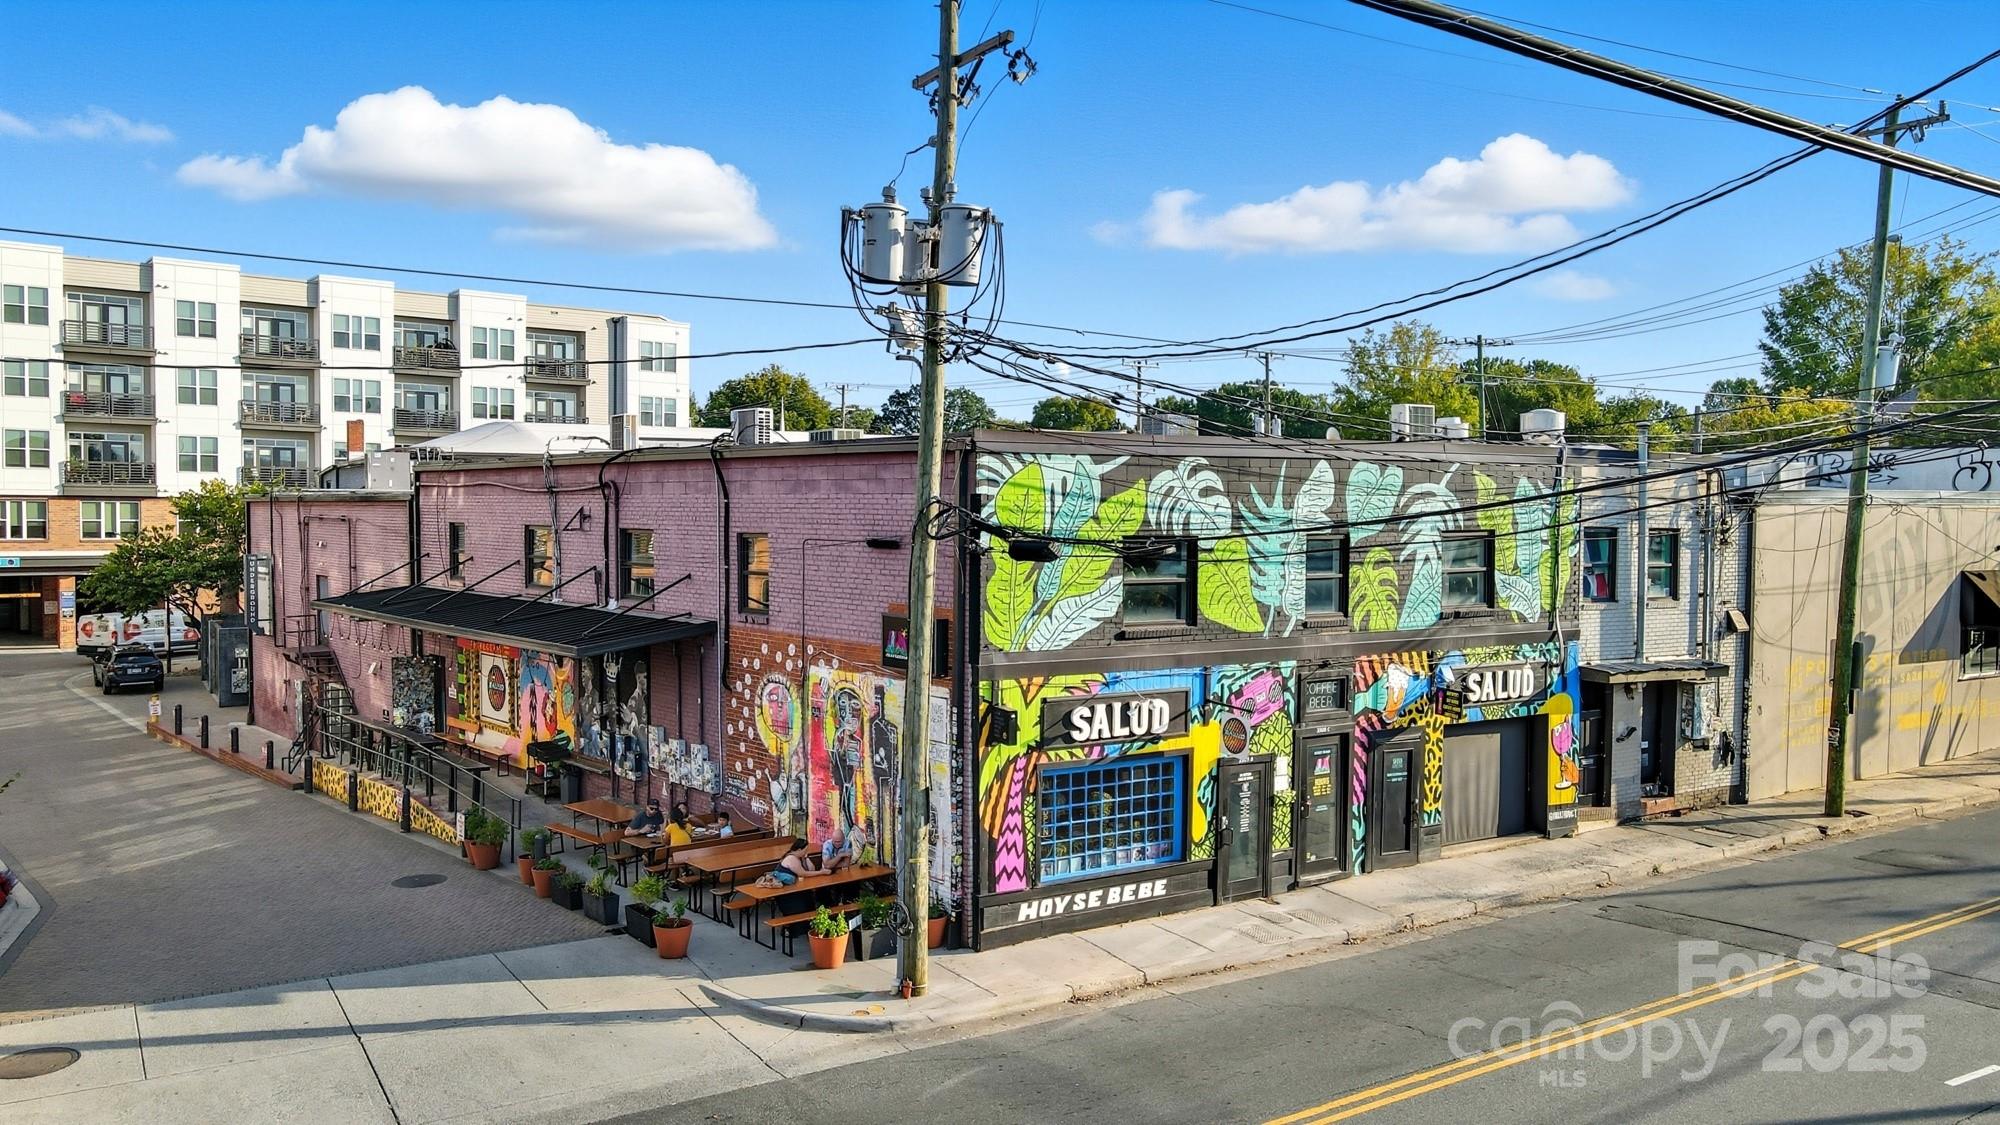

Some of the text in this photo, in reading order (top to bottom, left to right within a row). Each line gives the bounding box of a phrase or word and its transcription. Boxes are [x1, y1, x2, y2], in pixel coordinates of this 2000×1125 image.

[1309, 696, 1333, 709] BEER
[1467, 668, 1534, 702] SALUD
[1070, 699, 1170, 741] SALUD
[1018, 879, 1167, 921] HOY SE BEBE
